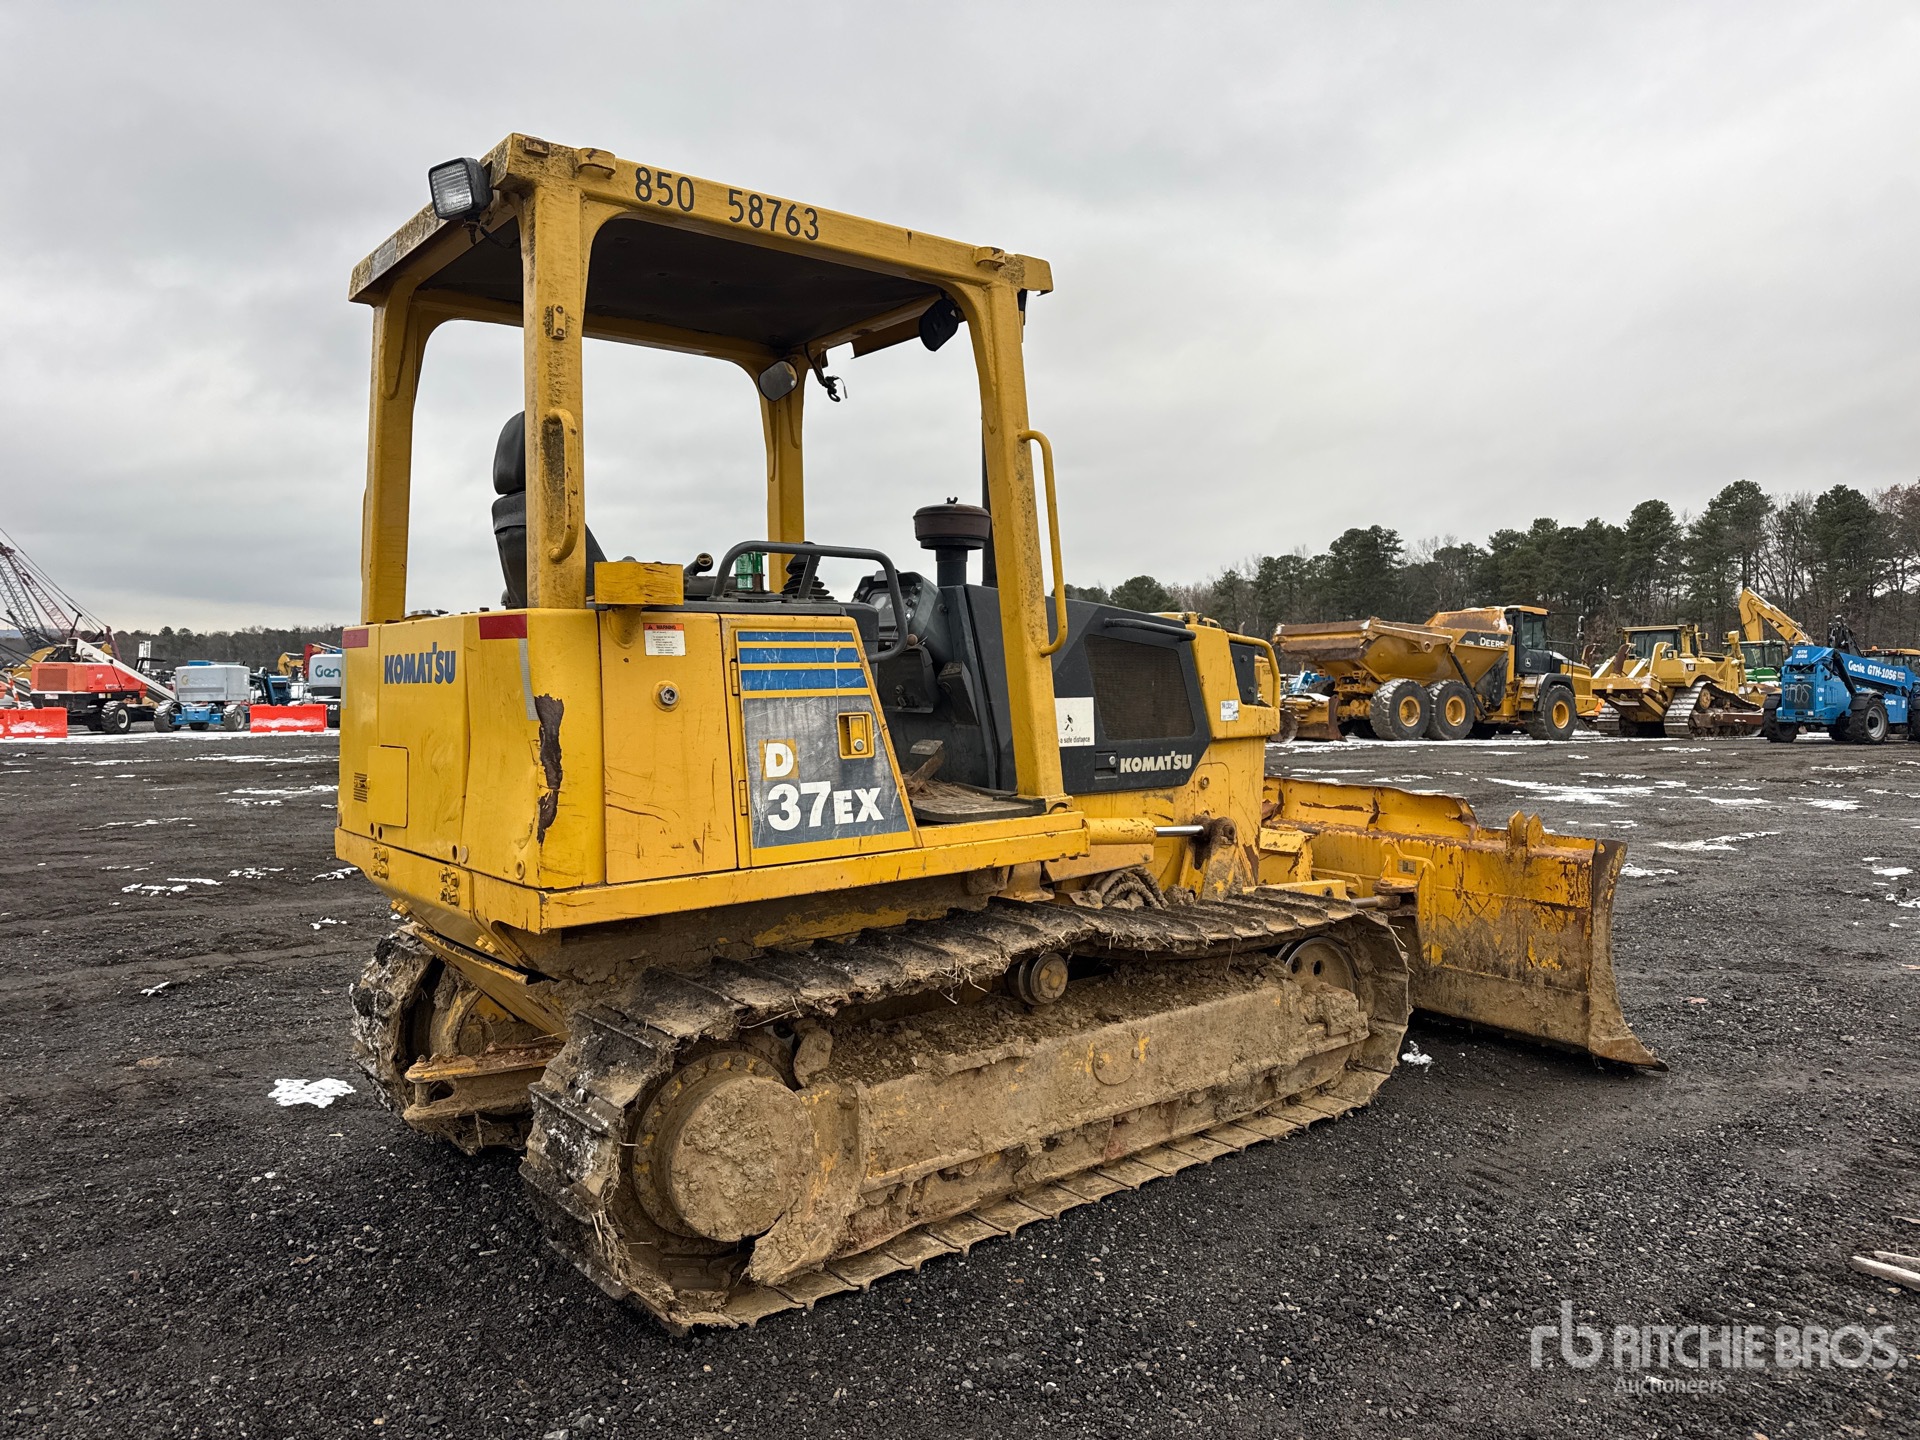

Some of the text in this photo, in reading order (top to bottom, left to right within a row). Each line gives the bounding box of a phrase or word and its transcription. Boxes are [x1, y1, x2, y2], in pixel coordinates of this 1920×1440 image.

[635, 166, 819, 241] 850 58763
[315, 664, 342, 678] Gen
[384, 642, 456, 684] KOMATSU
[1848, 660, 1866, 674] Genie
[1867, 664, 1897, 681] GTH-1056
[764, 743, 794, 778] D
[1119, 750, 1193, 774] KOMATSU
[767, 781, 885, 831] 37EX
